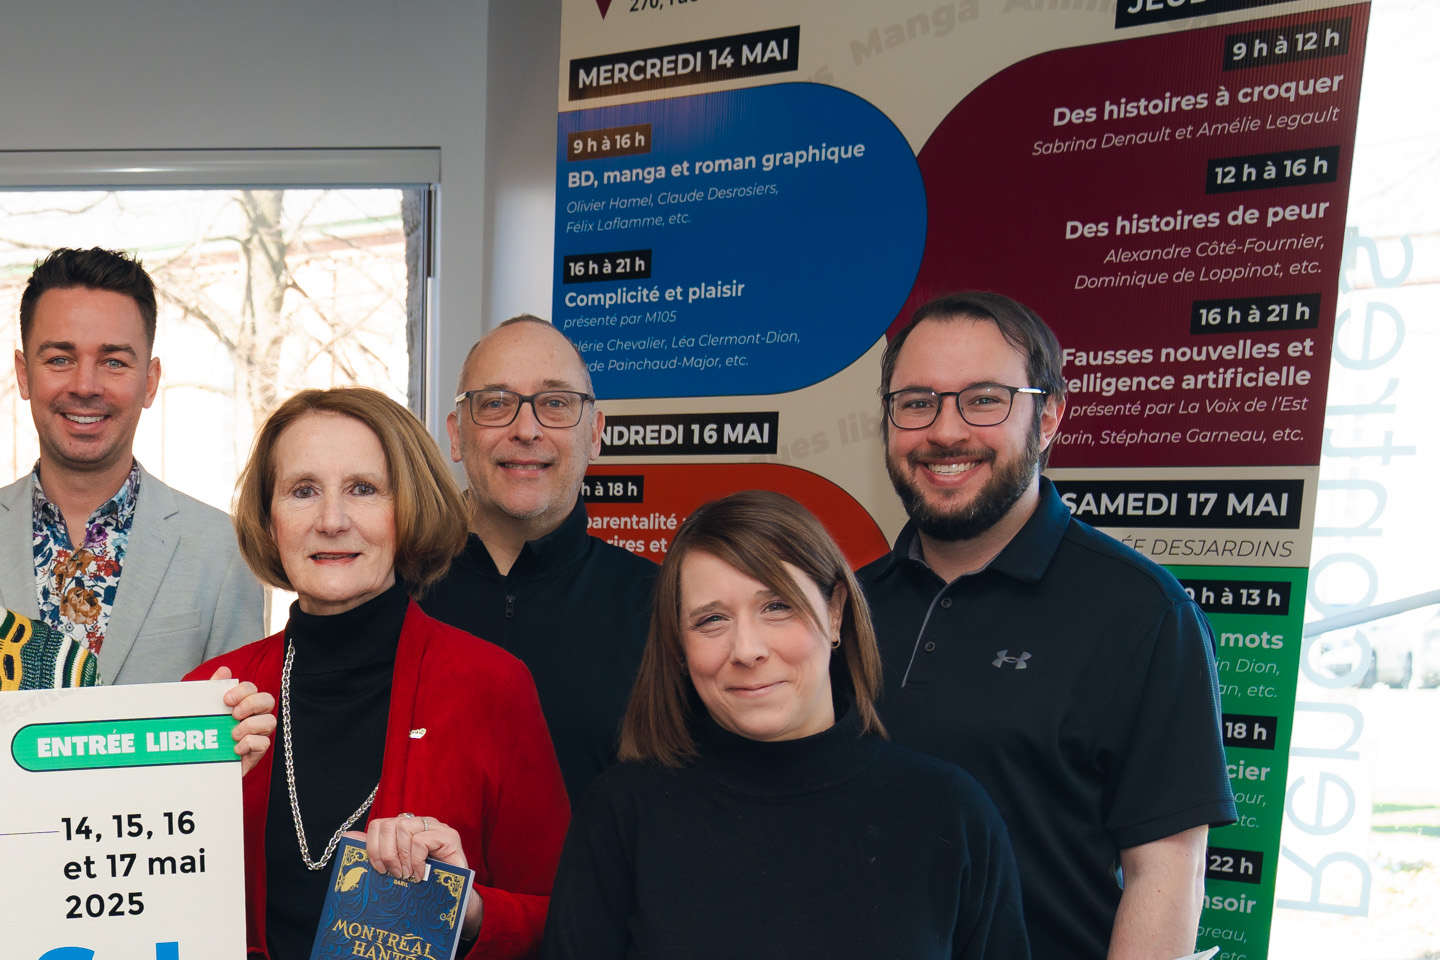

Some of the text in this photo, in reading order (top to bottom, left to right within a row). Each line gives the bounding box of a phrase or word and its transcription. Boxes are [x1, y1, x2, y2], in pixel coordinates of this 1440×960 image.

[1233, 29, 1339, 60] 9 h à 12 h
[578, 39, 788, 89] MERCREDI 14 MAI
[1054, 74, 1344, 126] Des histoires à croquer
[1032, 106, 1340, 155] Sabrina Denault et Amélie Legault
[568, 143, 865, 188] BD, manga et roman graphique
[567, 183, 778, 213] Olivier Hamel, Claude Desrosiers,
[566, 213, 690, 233] Félix Laflamme, etc.
[1066, 202, 1329, 239] Des histoires de peur
[1104, 234, 1324, 263] Alexandre Côté-Fournier,
[569, 257, 644, 276] 16 h à 21 h
[1075, 260, 1321, 289] Dominique de Loppinot, etc.
[565, 280, 744, 308] Complicité et plaisir
[564, 310, 676, 330] présenté par M105
[607, 331, 800, 351] Chevalier, Léa Clermont-Dion,
[1062, 338, 1314, 367] Fausses nouvelles et
[608, 355, 748, 370] Painchaud-Major, etc.
[1182, 366, 1310, 389] artificielle
[1070, 396, 1308, 419] présenté par La Voix de l'Est
[691, 423, 769, 444] 16 MAI
[1100, 428, 1303, 446] Stéphane Garneau, etc.
[1060, 493, 1288, 516] SAMEDI 17 MAI
[650, 538, 667, 552] et
[1151, 540, 1293, 557] DESJARDINS
[1221, 632, 1283, 649] mots
[1236, 659, 1279, 676] Dion,
[38, 729, 218, 757] ENTRÉE LIBRE
[62, 811, 195, 842] 14, 15, 16
[64, 848, 205, 880] et 17 mai
[394, 879, 408, 887] BARIL
[66, 892, 144, 918] 2025
